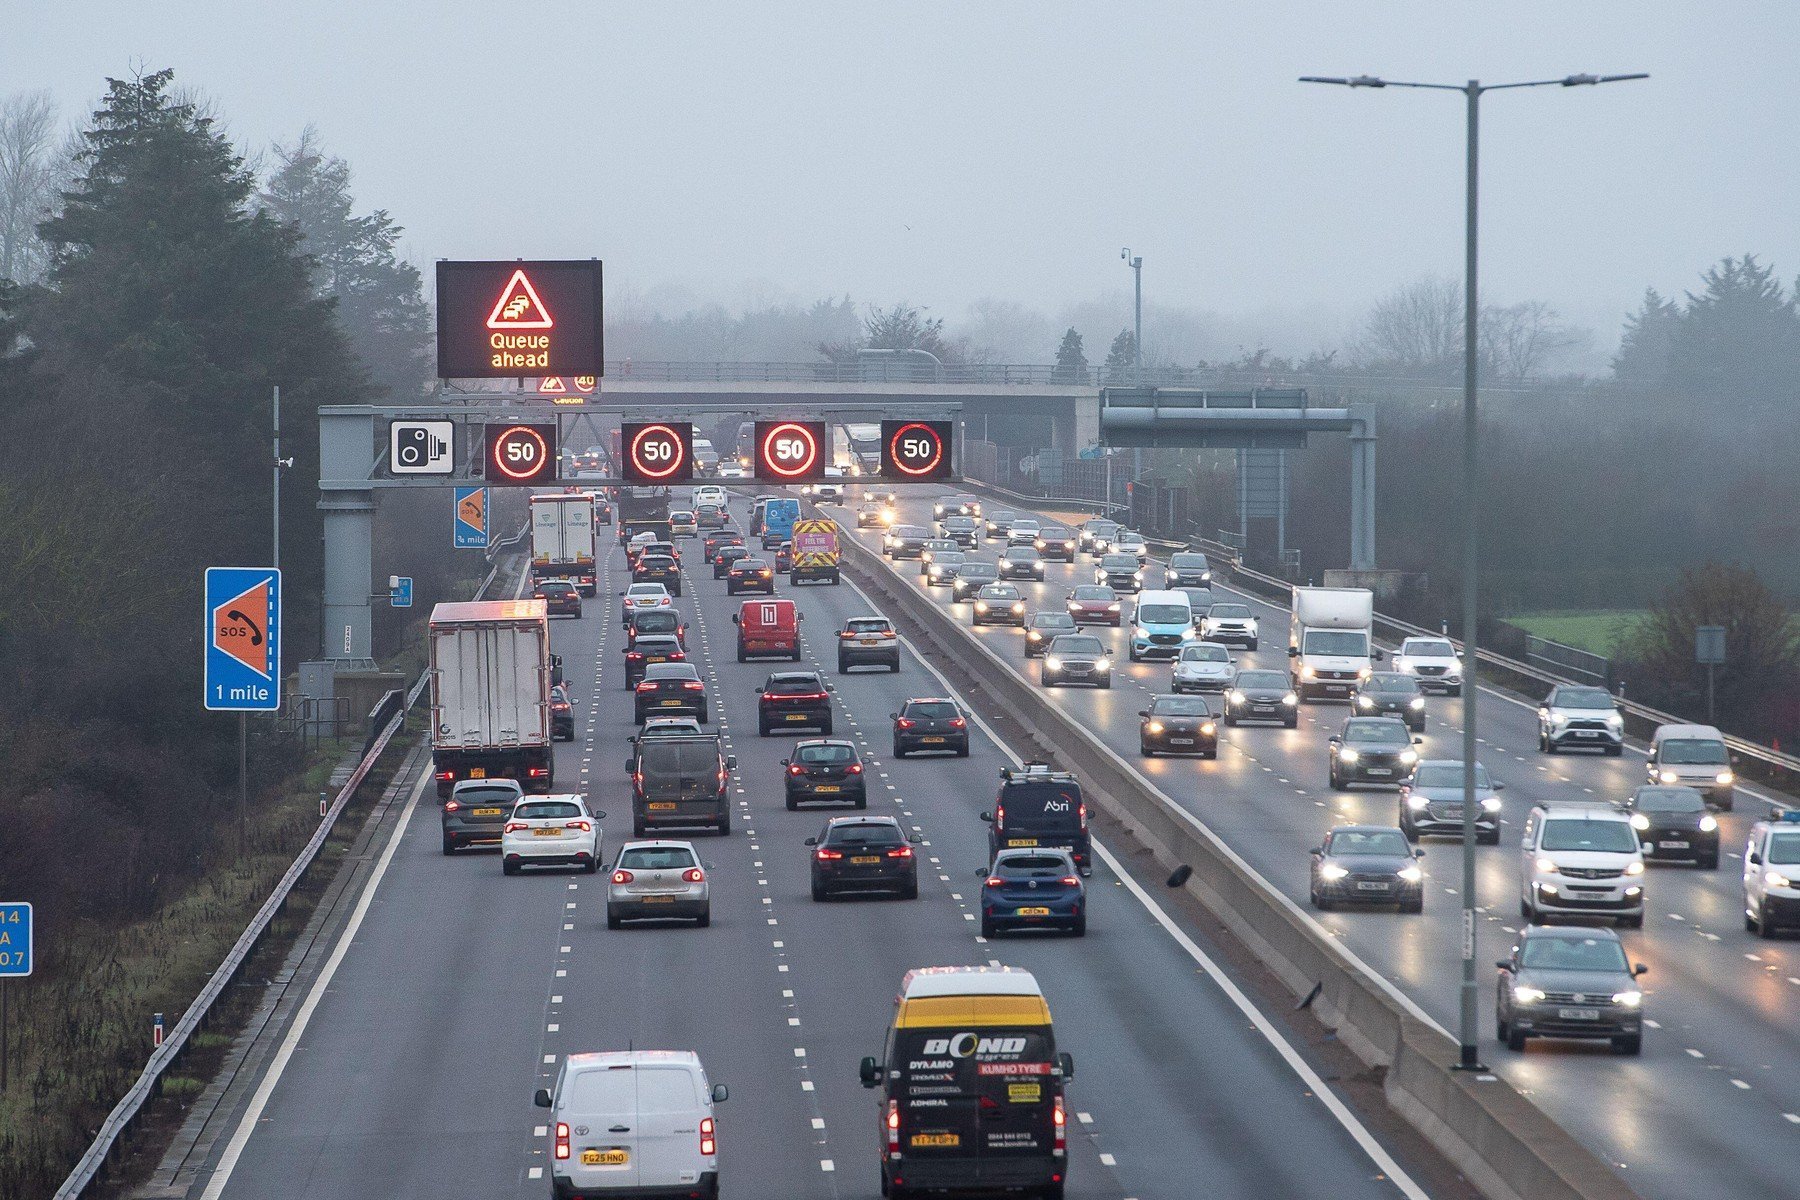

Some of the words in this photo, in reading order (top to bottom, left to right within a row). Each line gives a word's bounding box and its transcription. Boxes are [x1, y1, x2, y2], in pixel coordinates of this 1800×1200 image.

[490, 332, 550, 349] Queue
[491, 351, 549, 367] ahead
[578, 376, 595, 385] 40
[507, 442, 535, 461] 50
[644, 441, 672, 461] 50
[776, 439, 805, 460] 50
[903, 439, 930, 458] 50
[467, 535, 486, 544] mile
[220, 626, 247, 637] SOS
[216, 684, 223, 700] 1
[230, 684, 269, 700] mile
[1044, 800, 1069, 812] Abri
[0, 931, 11, 945] A
[923, 1032, 1027, 1059] BOND
[909, 1060, 955, 1070] DYNAMO
[981, 1064, 1017, 1075] KUMHO
[1017, 1063, 1042, 1074] TYRE
[910, 1099, 948, 1108] ADMIRAL
[583, 1154, 606, 1163] FG25
